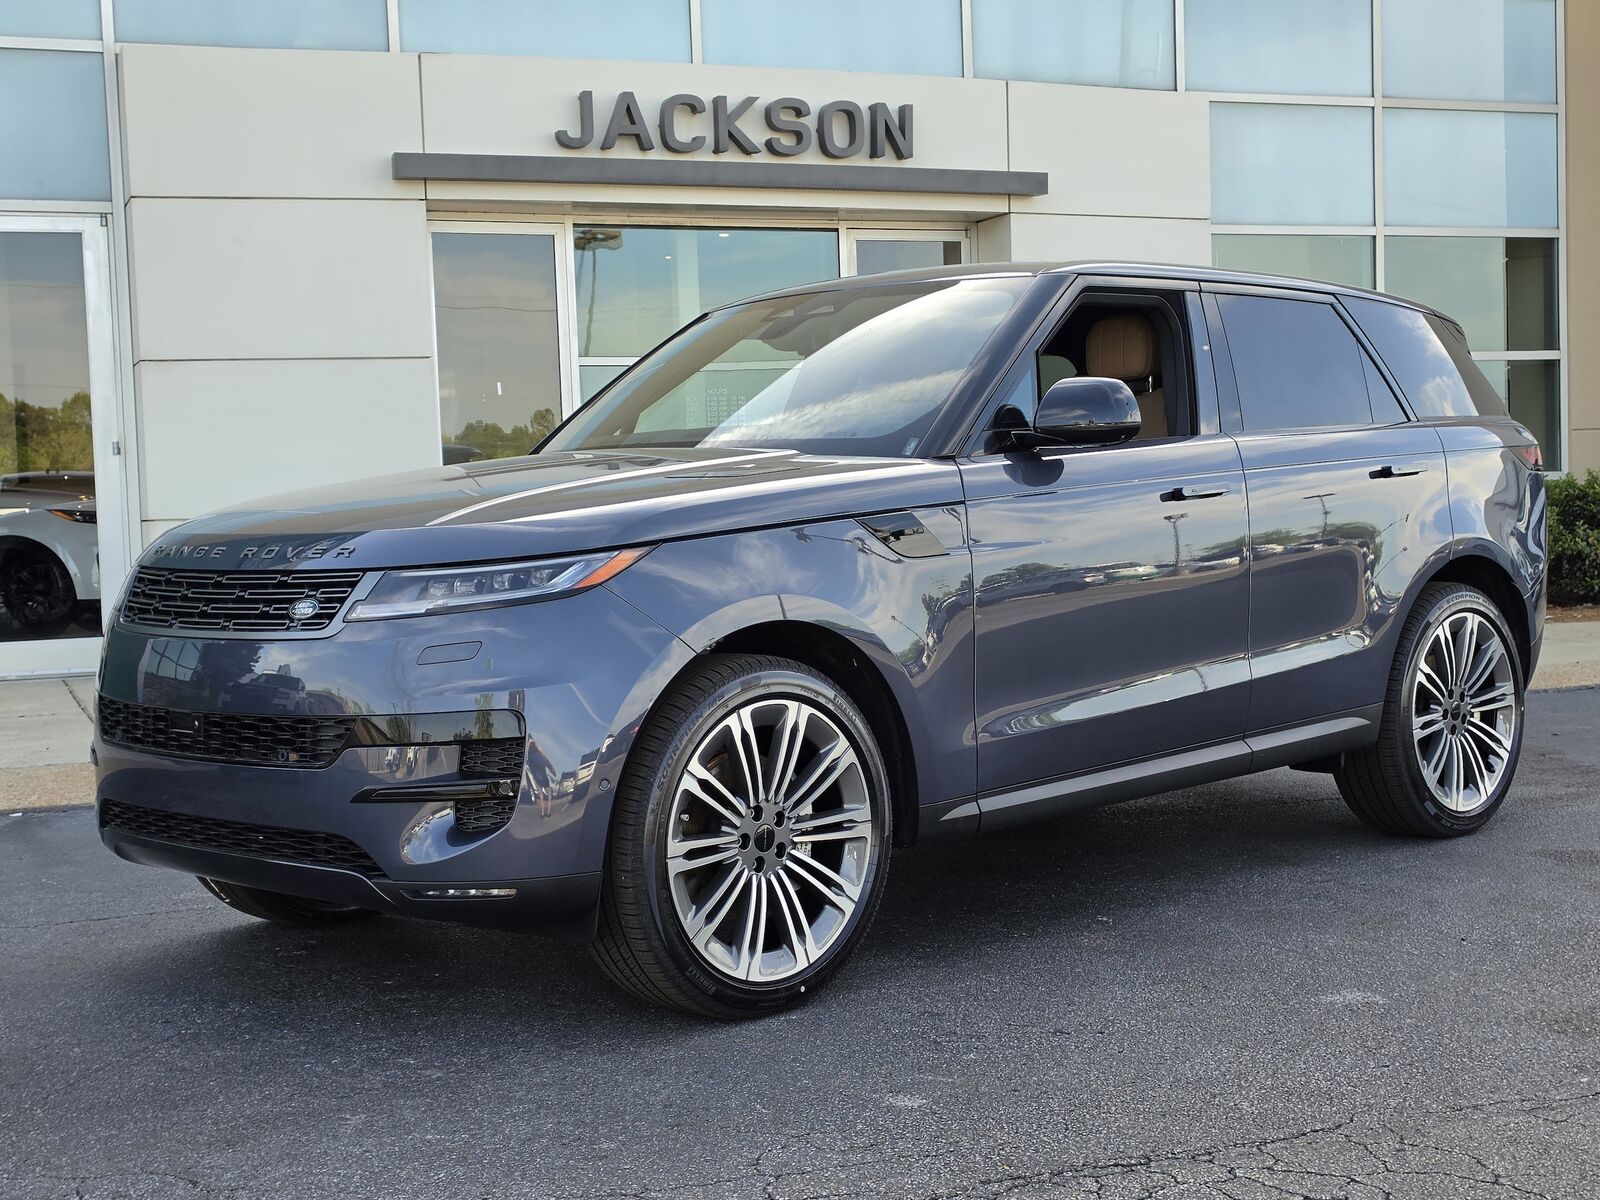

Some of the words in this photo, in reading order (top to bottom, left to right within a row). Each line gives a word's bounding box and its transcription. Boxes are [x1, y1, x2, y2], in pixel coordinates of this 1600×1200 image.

[555, 90, 914, 160] JACKSON
[153, 544, 228, 559] RANGE
[239, 545, 356, 561] ROVER
[1446, 593, 1481, 605] SCORPION
